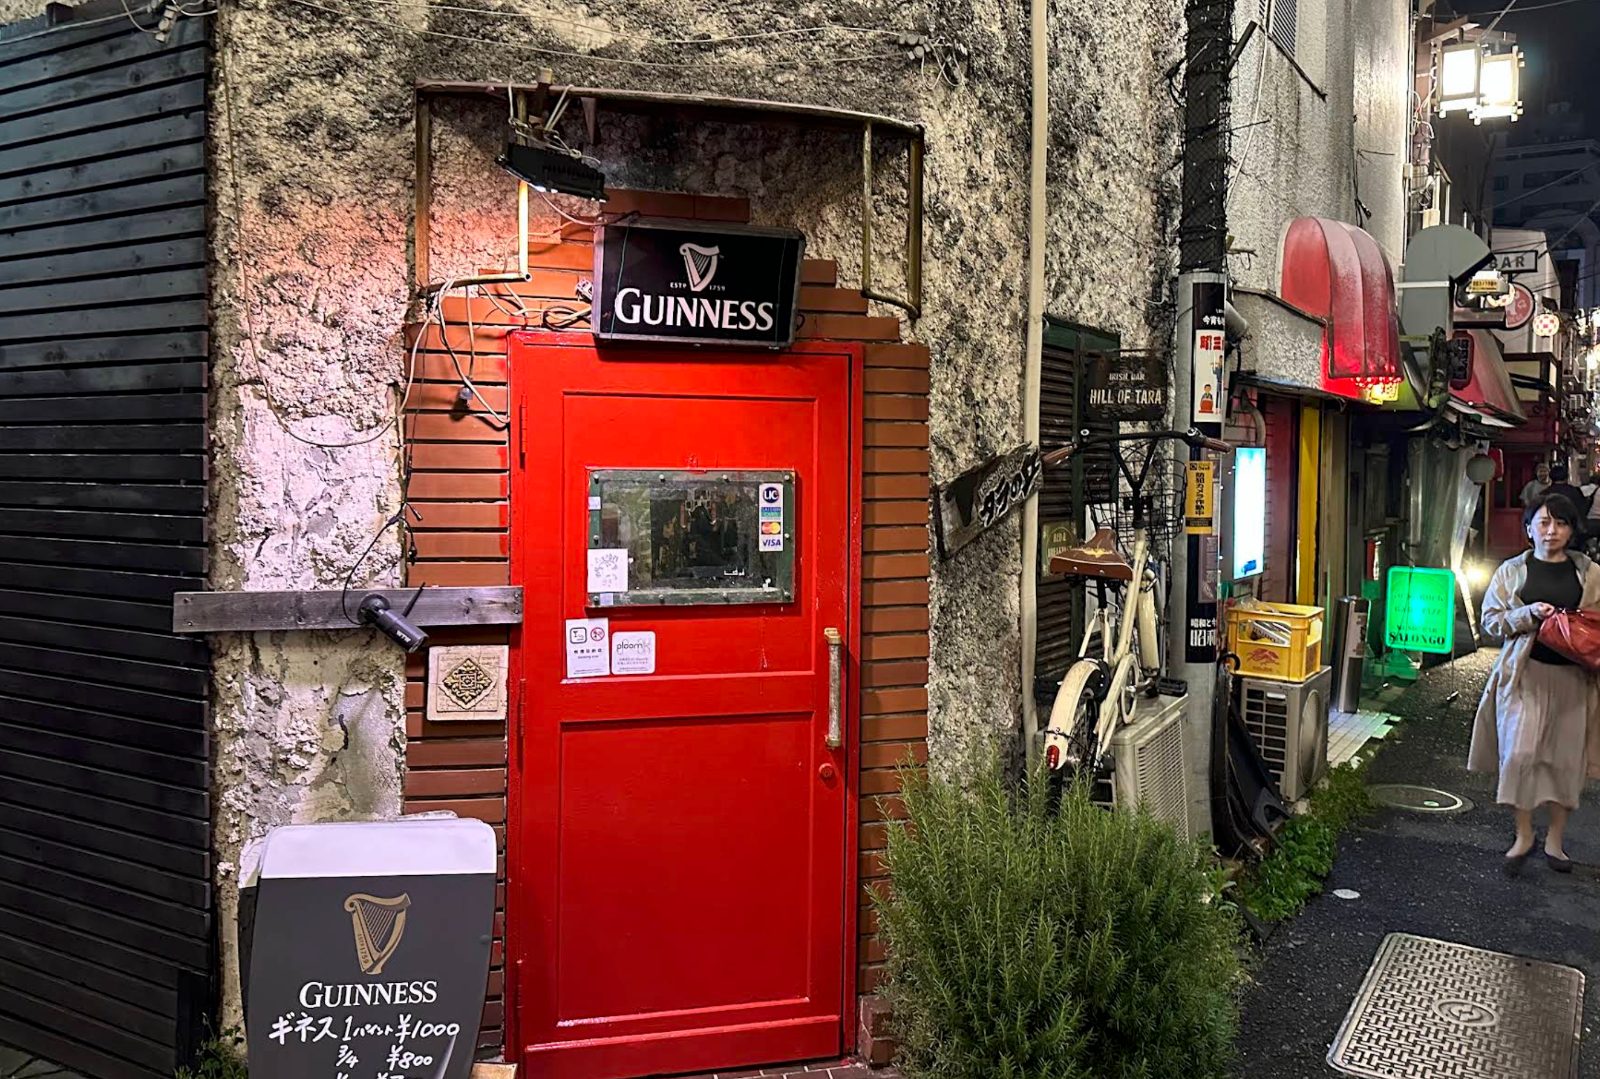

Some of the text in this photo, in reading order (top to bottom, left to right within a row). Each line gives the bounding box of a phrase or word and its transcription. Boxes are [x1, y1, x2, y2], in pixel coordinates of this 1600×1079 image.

[709, 284, 726, 292] 1759
[614, 287, 774, 331] GUINNESS
[1089, 388, 1162, 405] HILL OF TARA
[1194, 472, 1205, 517] 防犯カメラ作動中
[762, 538, 782, 547] VISA
[1389, 632, 1446, 645] SALONGO
[299, 980, 438, 1008] GUINNESS
[268, 1011, 338, 1045] ギネス
[395, 1013, 460, 1043] ¥1000
[336, 1044, 433, 1071] 3/4 ¥800
